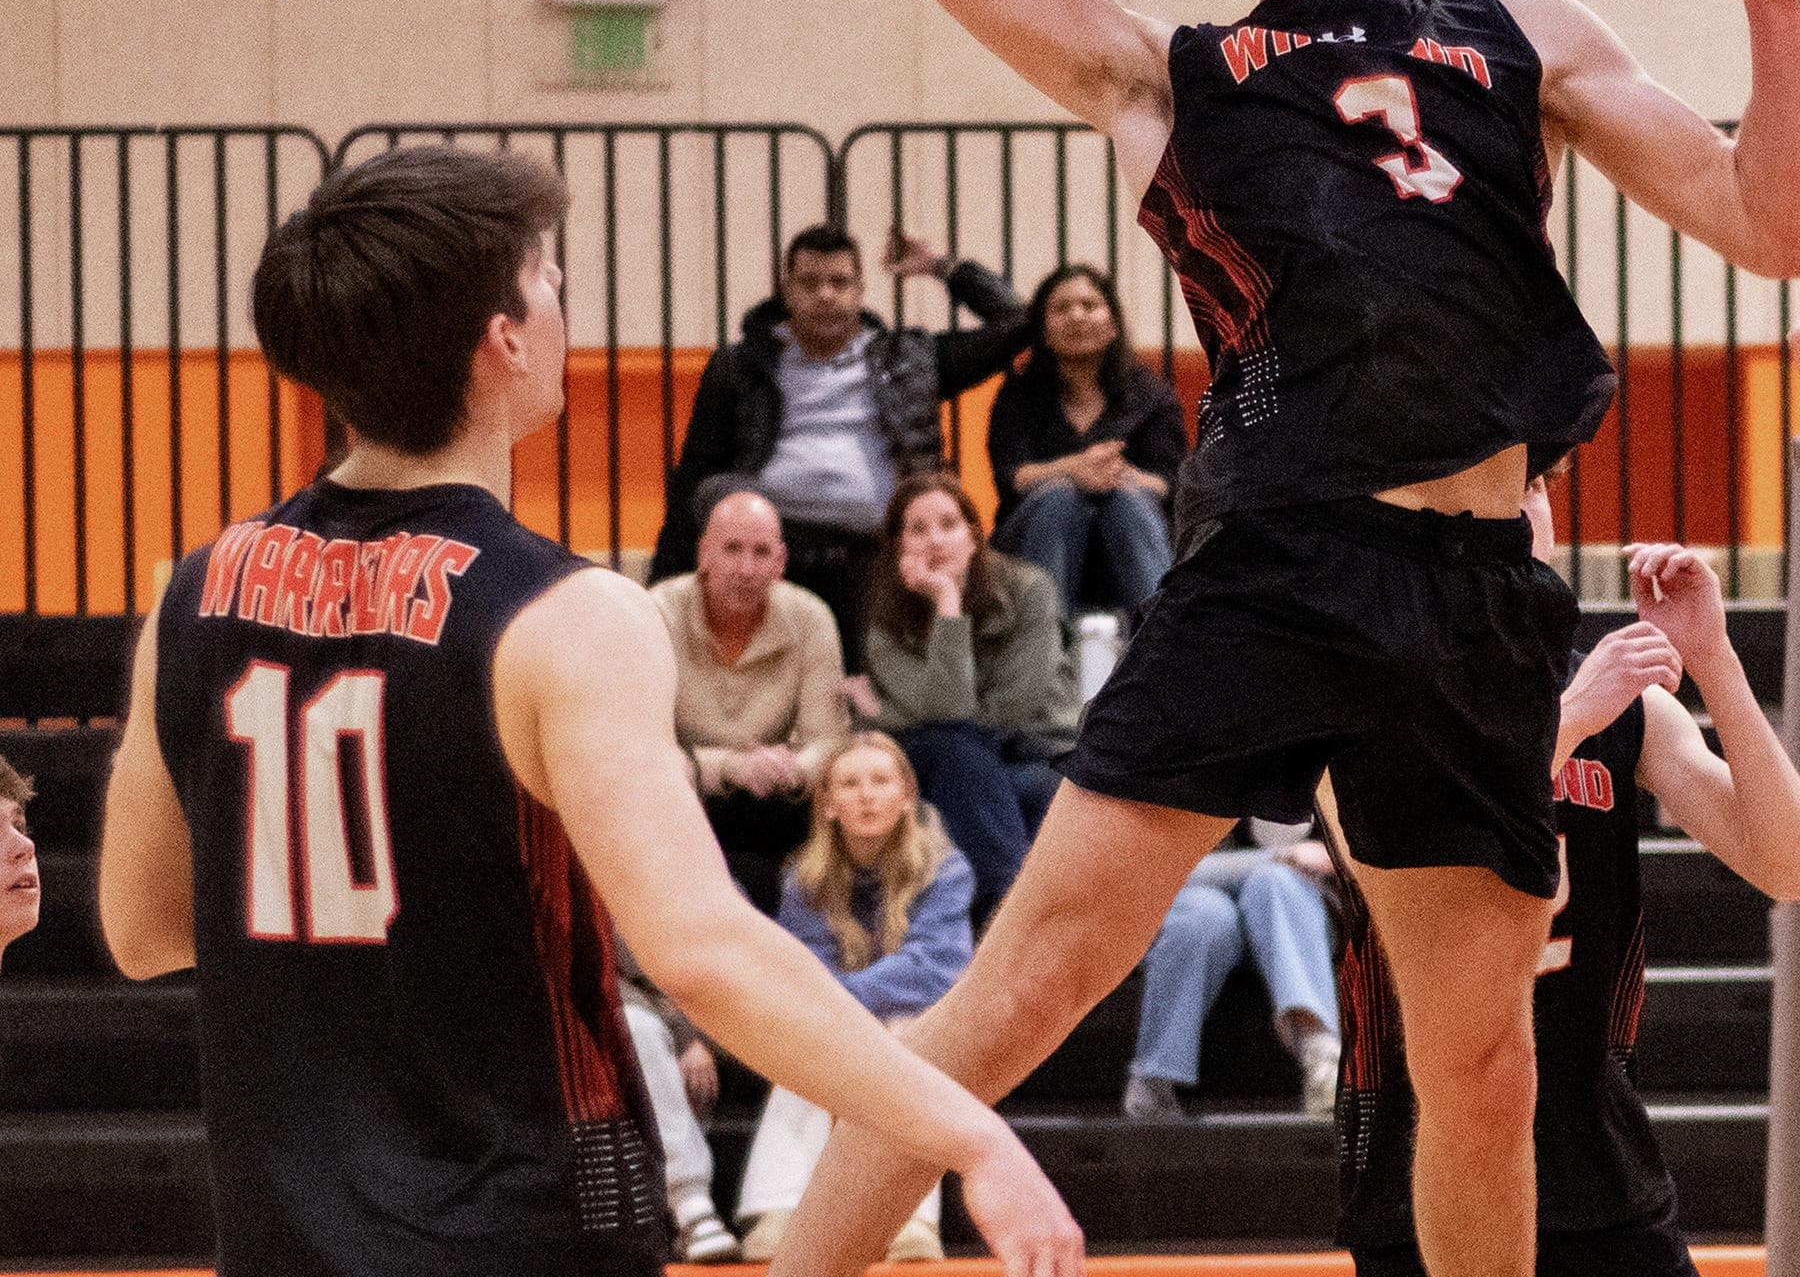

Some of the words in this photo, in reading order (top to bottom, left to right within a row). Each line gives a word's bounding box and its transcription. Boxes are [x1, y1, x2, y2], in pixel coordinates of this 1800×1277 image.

[1333, 74, 1464, 204] 3
[198, 520, 481, 646] WARRORS
[224, 658, 400, 946] 10
